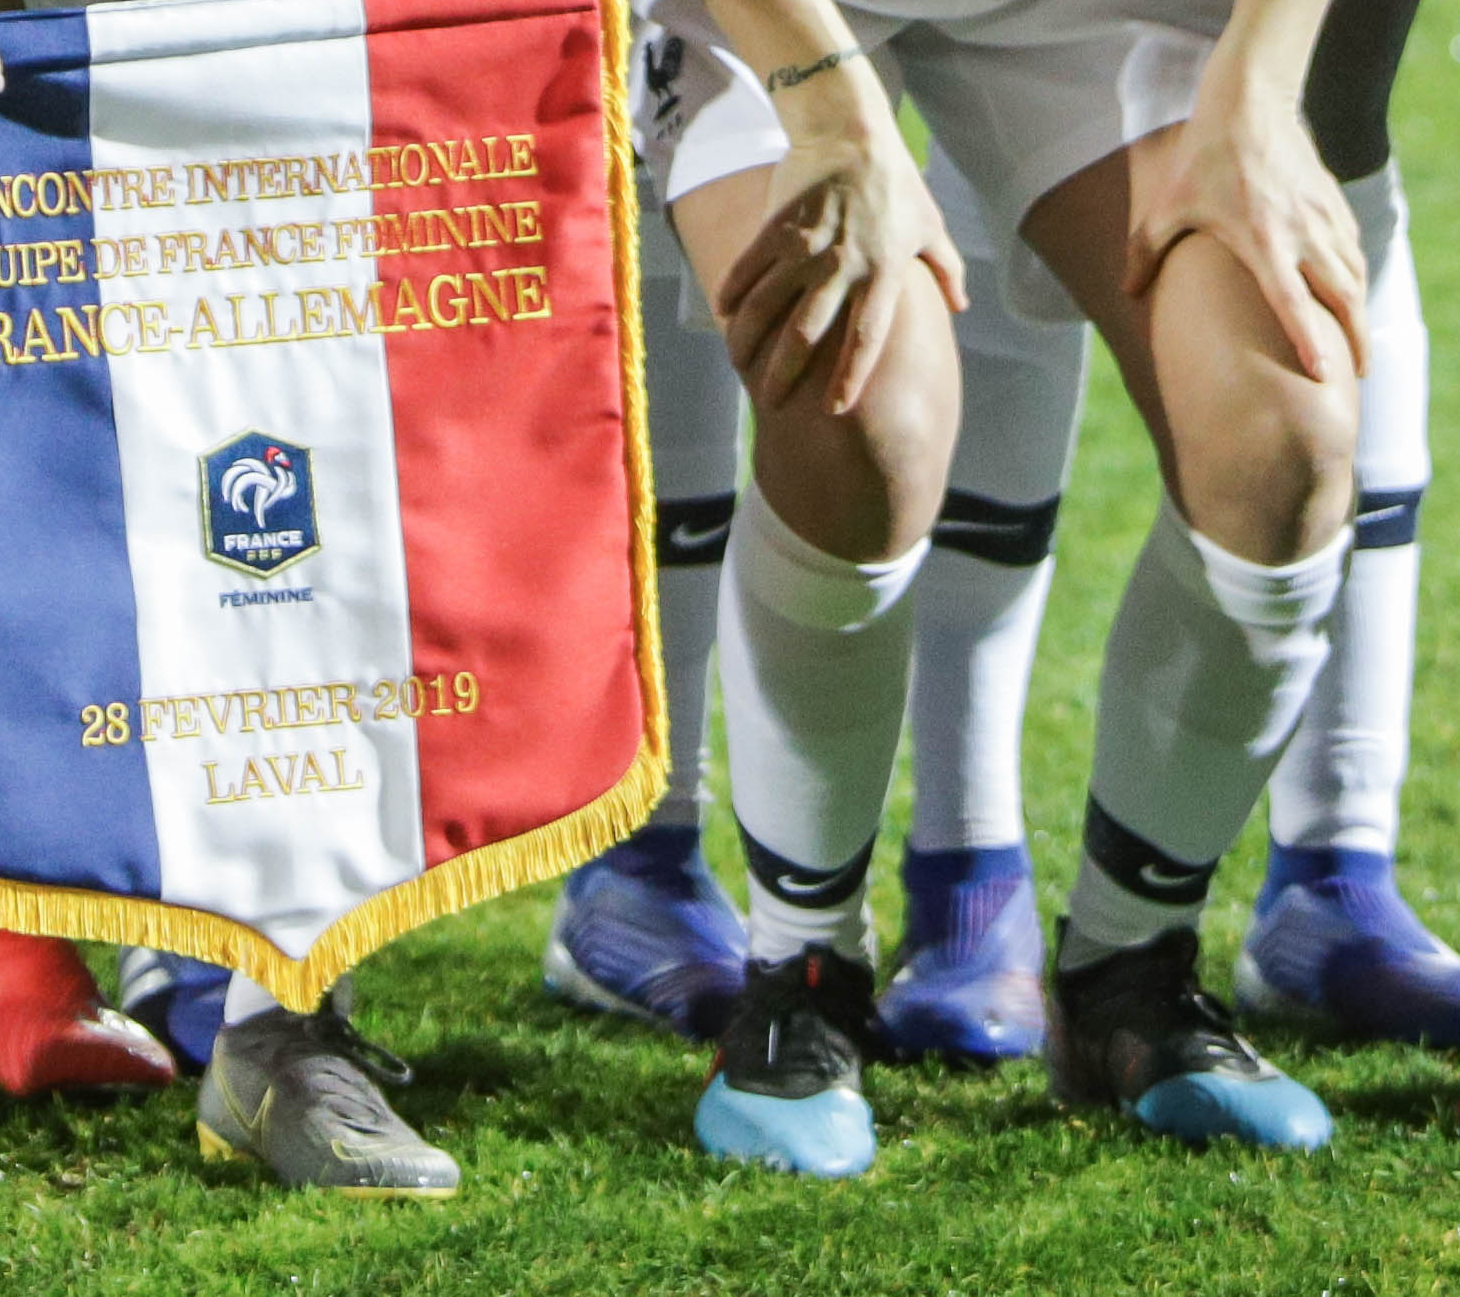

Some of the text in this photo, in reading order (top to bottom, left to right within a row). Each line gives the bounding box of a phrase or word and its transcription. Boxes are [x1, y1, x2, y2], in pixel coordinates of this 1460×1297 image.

[183, 133, 539, 205] INTERNATIONALE
[91, 237, 149, 280] DE
[159, 223, 325, 273] FRANCE
[333, 200, 543, 261] FEMININE
[223, 530, 304, 552] FRANCE
[81, 671, 481, 748] 28 FEVRIER 2019
[201, 748, 364, 805] LAVAL
